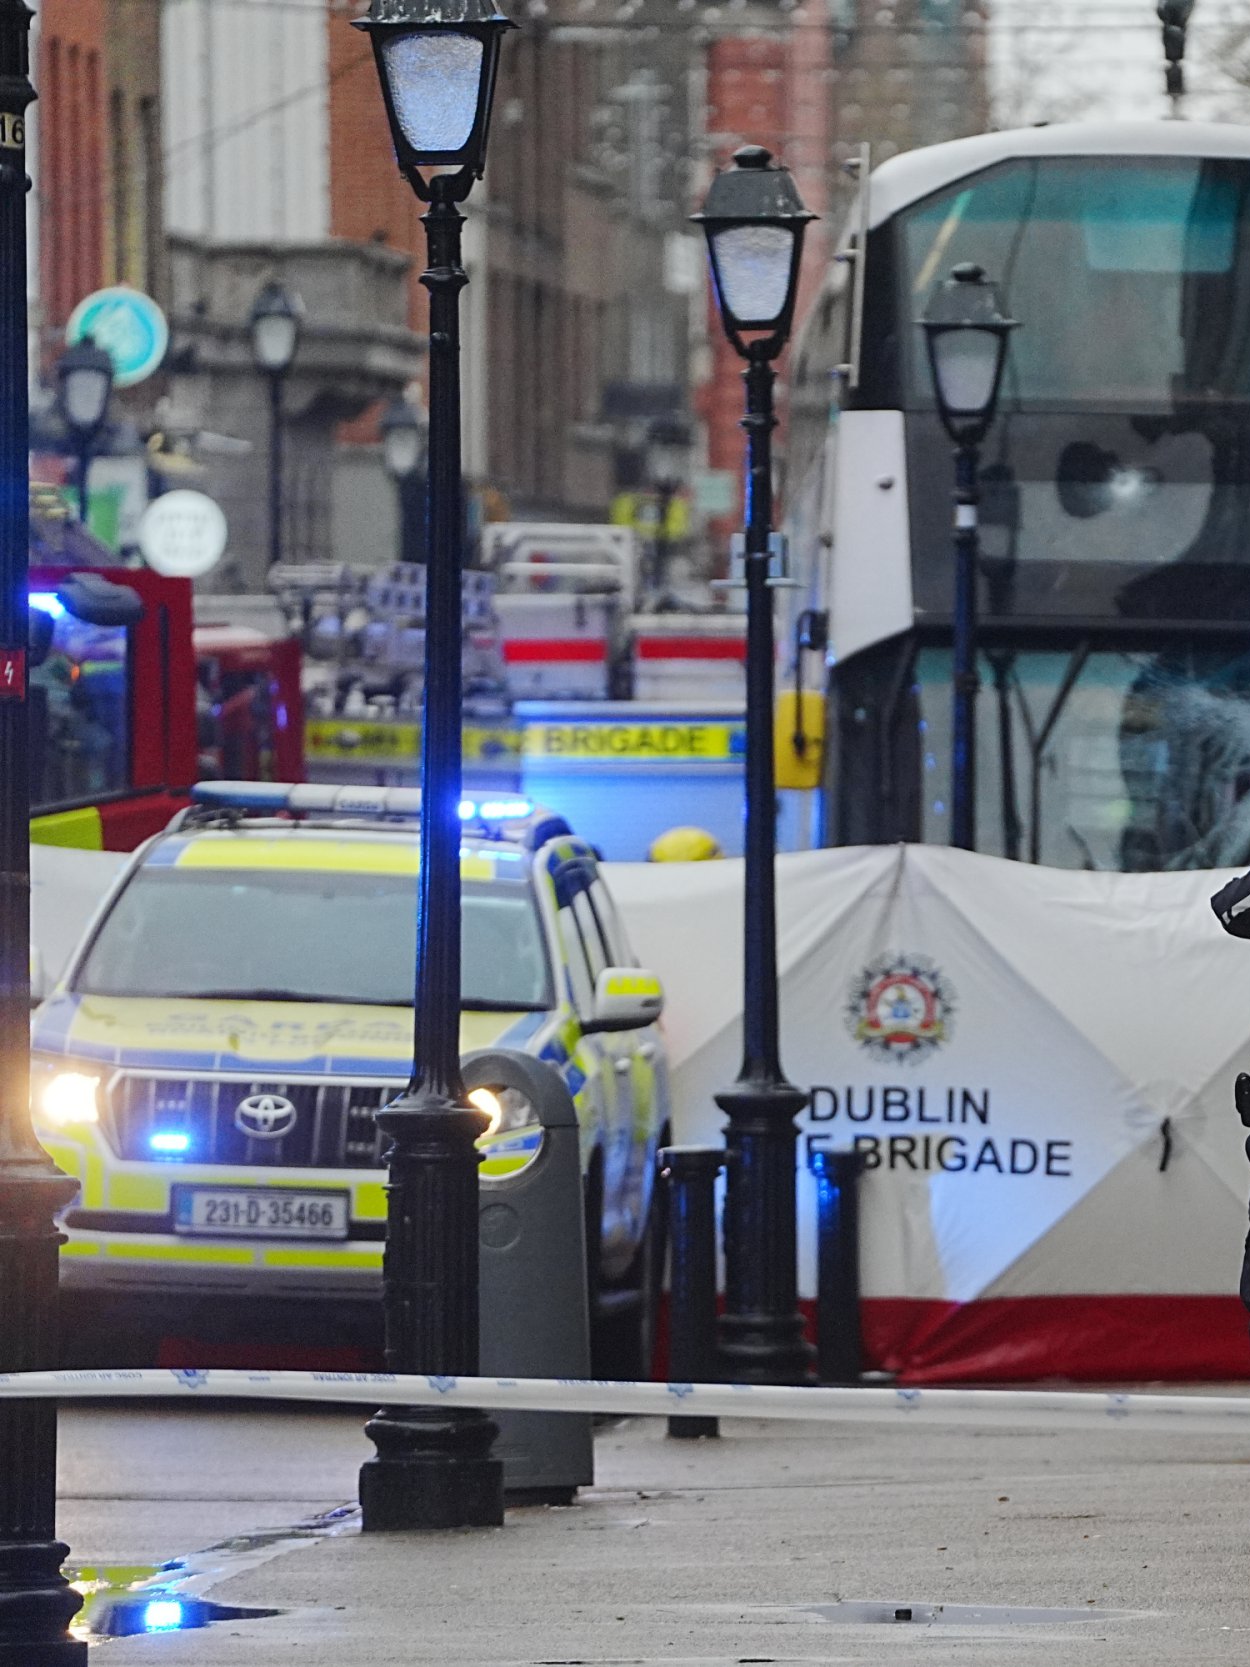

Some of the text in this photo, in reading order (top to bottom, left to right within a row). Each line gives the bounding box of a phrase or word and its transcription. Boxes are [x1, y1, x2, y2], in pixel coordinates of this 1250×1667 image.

[546, 726, 704, 752] BRIGADE
[808, 1086, 990, 1125] DUBLIN
[853, 1134, 1073, 1177] BRIGADE
[205, 1198, 334, 1226] 231-D-35466
